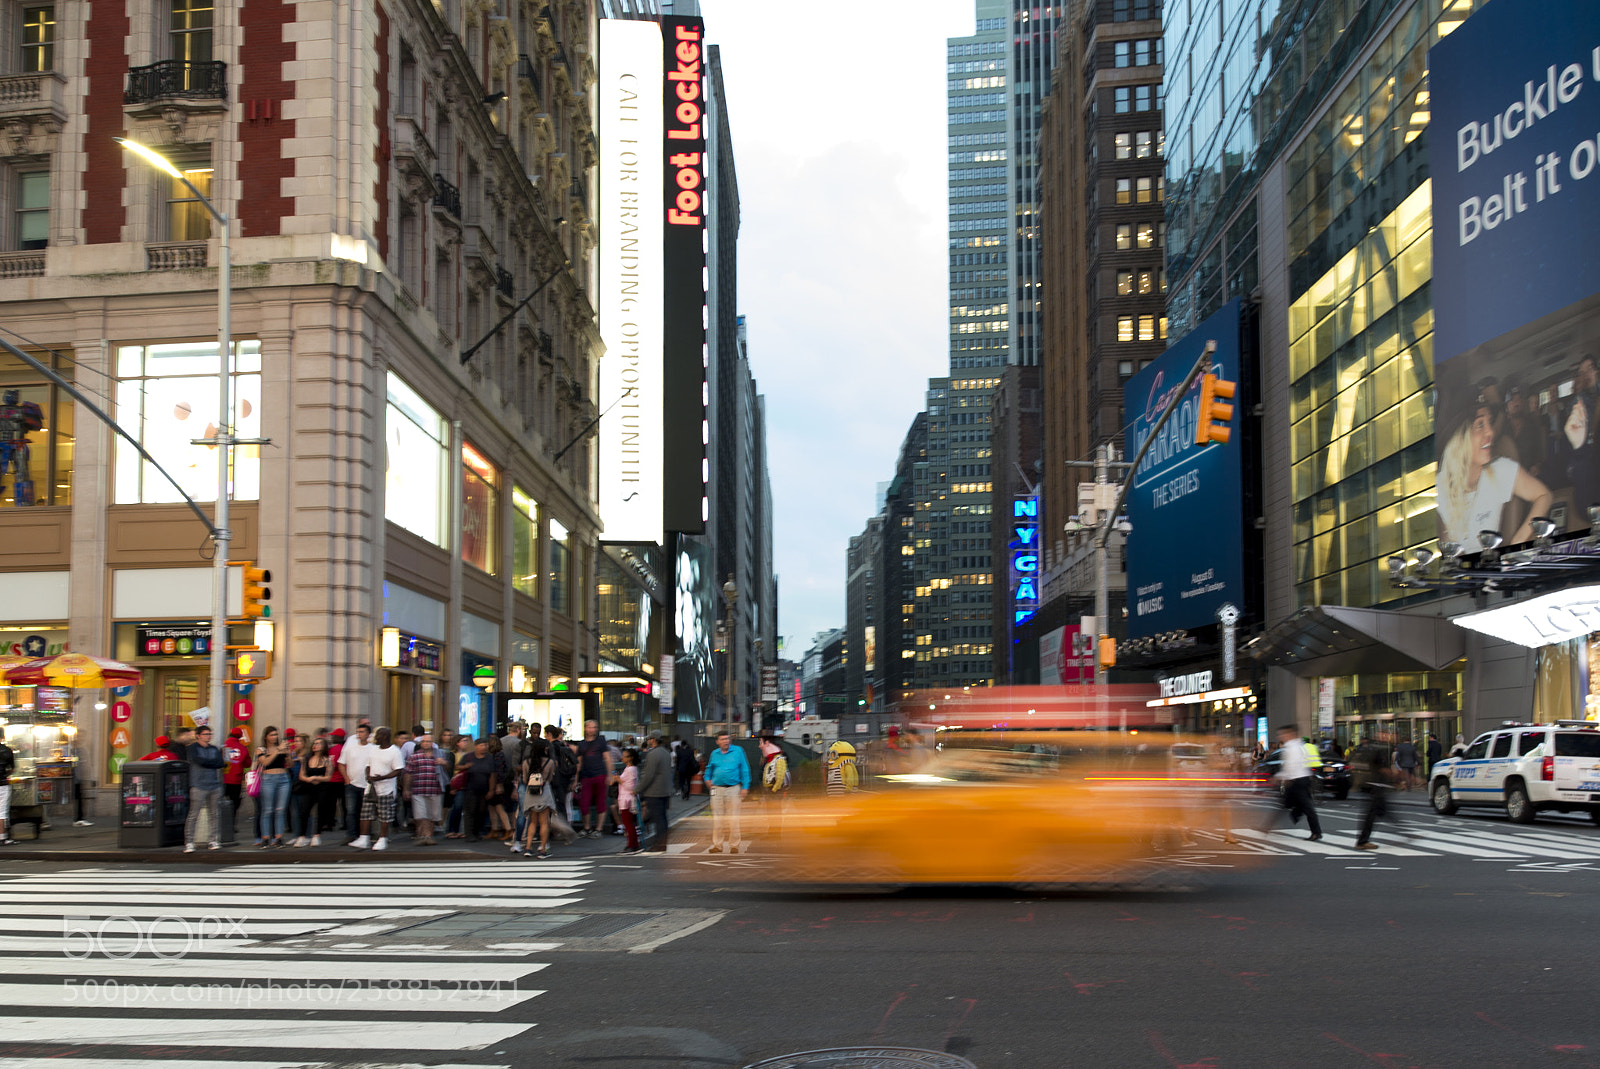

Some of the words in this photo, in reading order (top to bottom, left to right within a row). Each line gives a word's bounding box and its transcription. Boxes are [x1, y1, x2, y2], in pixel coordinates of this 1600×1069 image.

[1457, 62, 1583, 173] Buckle
[667, 152, 701, 226] Foot
[1459, 171, 1527, 247] Belt
[1535, 151, 1562, 203] it
[1152, 483, 1169, 510] THE
[1168, 468, 1201, 503] SERIES
[145, 629, 166, 637] Times
[166, 629, 192, 638] Square
[145, 638, 211, 654] HELL
[1159, 677, 1175, 698] THE
[1173, 670, 1213, 695] COUNTER
[1454, 767, 1476, 779] NYPD
